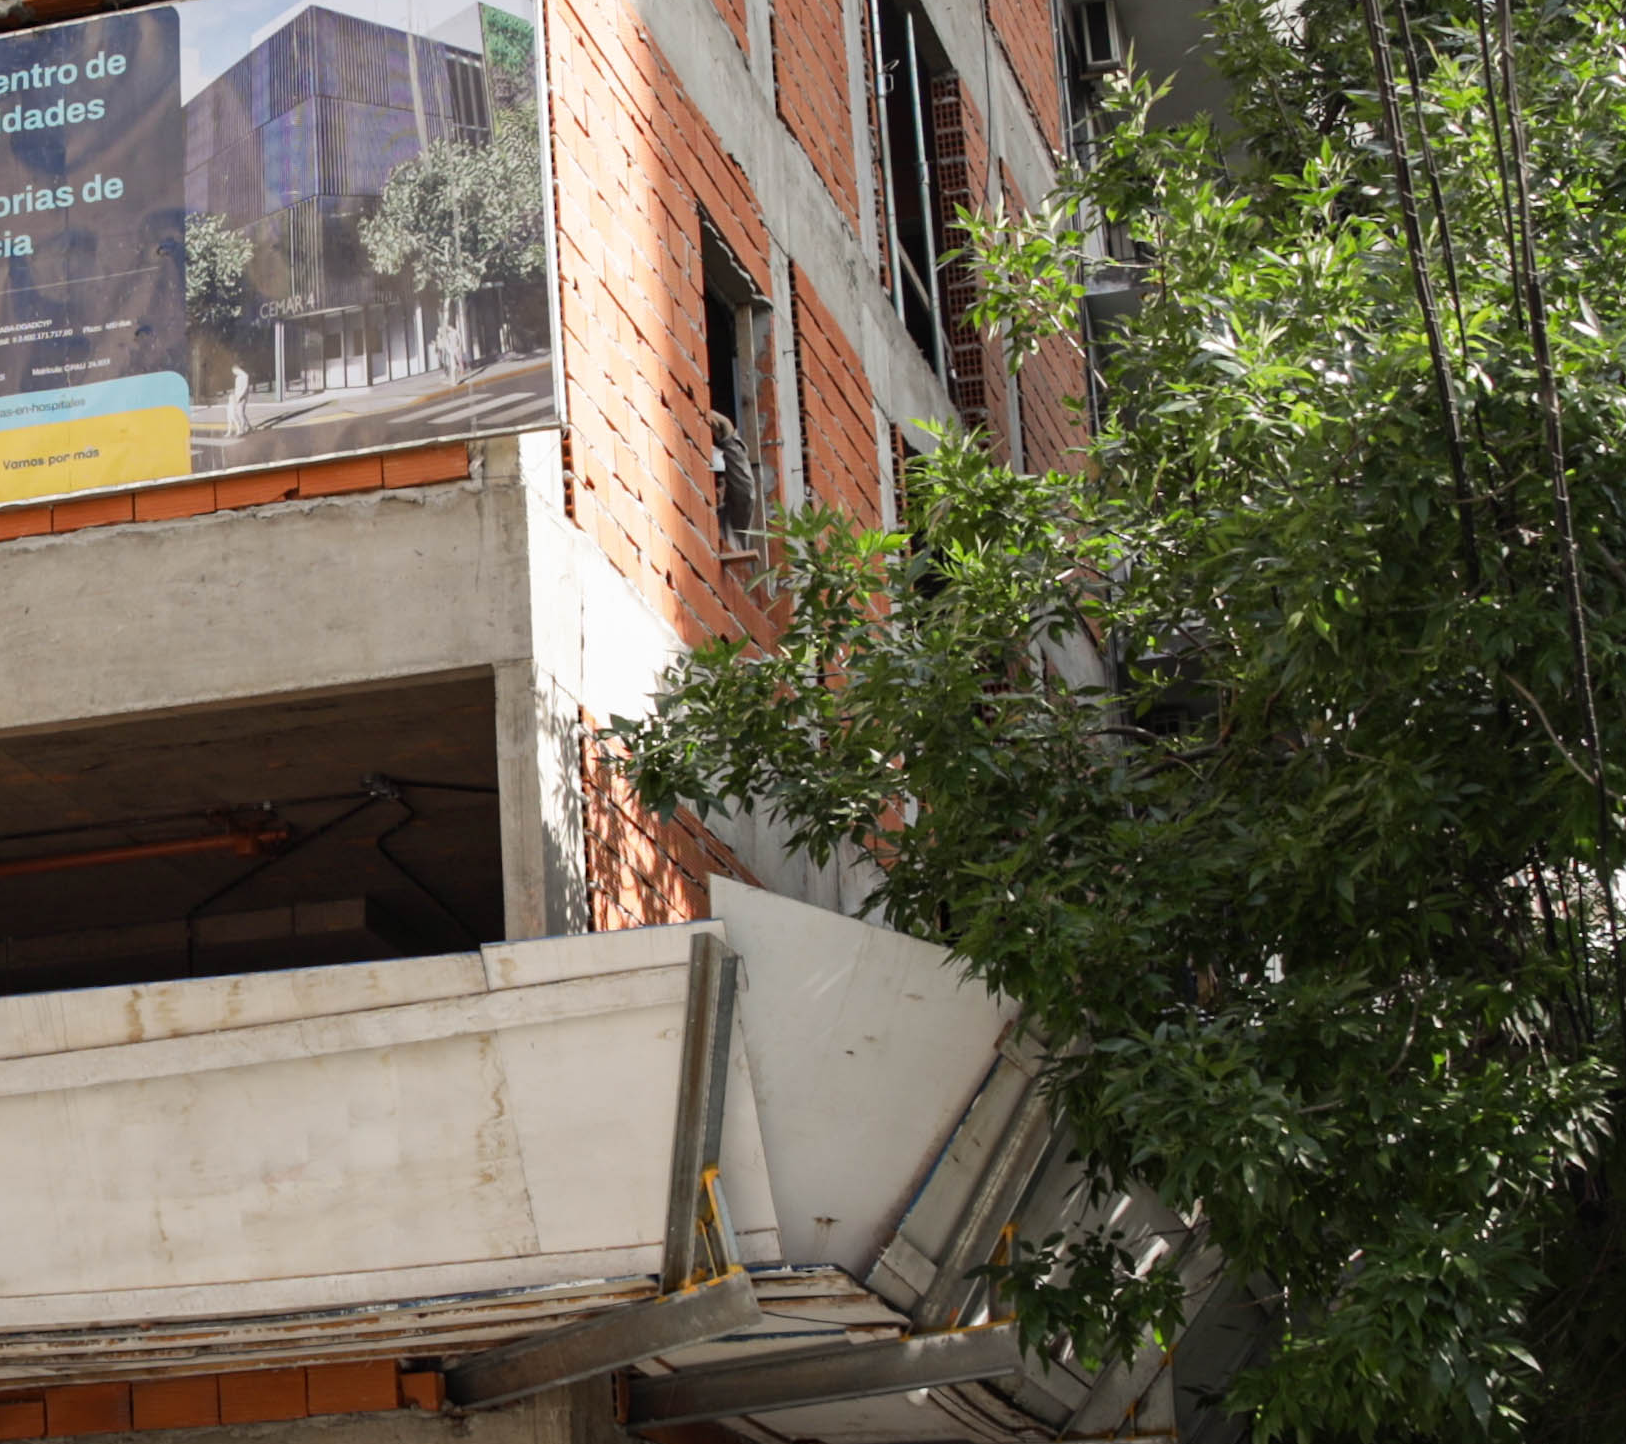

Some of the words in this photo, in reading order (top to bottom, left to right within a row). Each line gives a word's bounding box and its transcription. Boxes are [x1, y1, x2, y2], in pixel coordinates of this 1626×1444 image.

[86, 51, 126, 79] de
[82, 174, 123, 204] de
[260, 295, 303, 318] CEMAR
[306, 291, 315, 307] 4
[3, 454, 45, 470] Vamos
[48, 453, 71, 467] por
[74, 447, 100, 460] más
